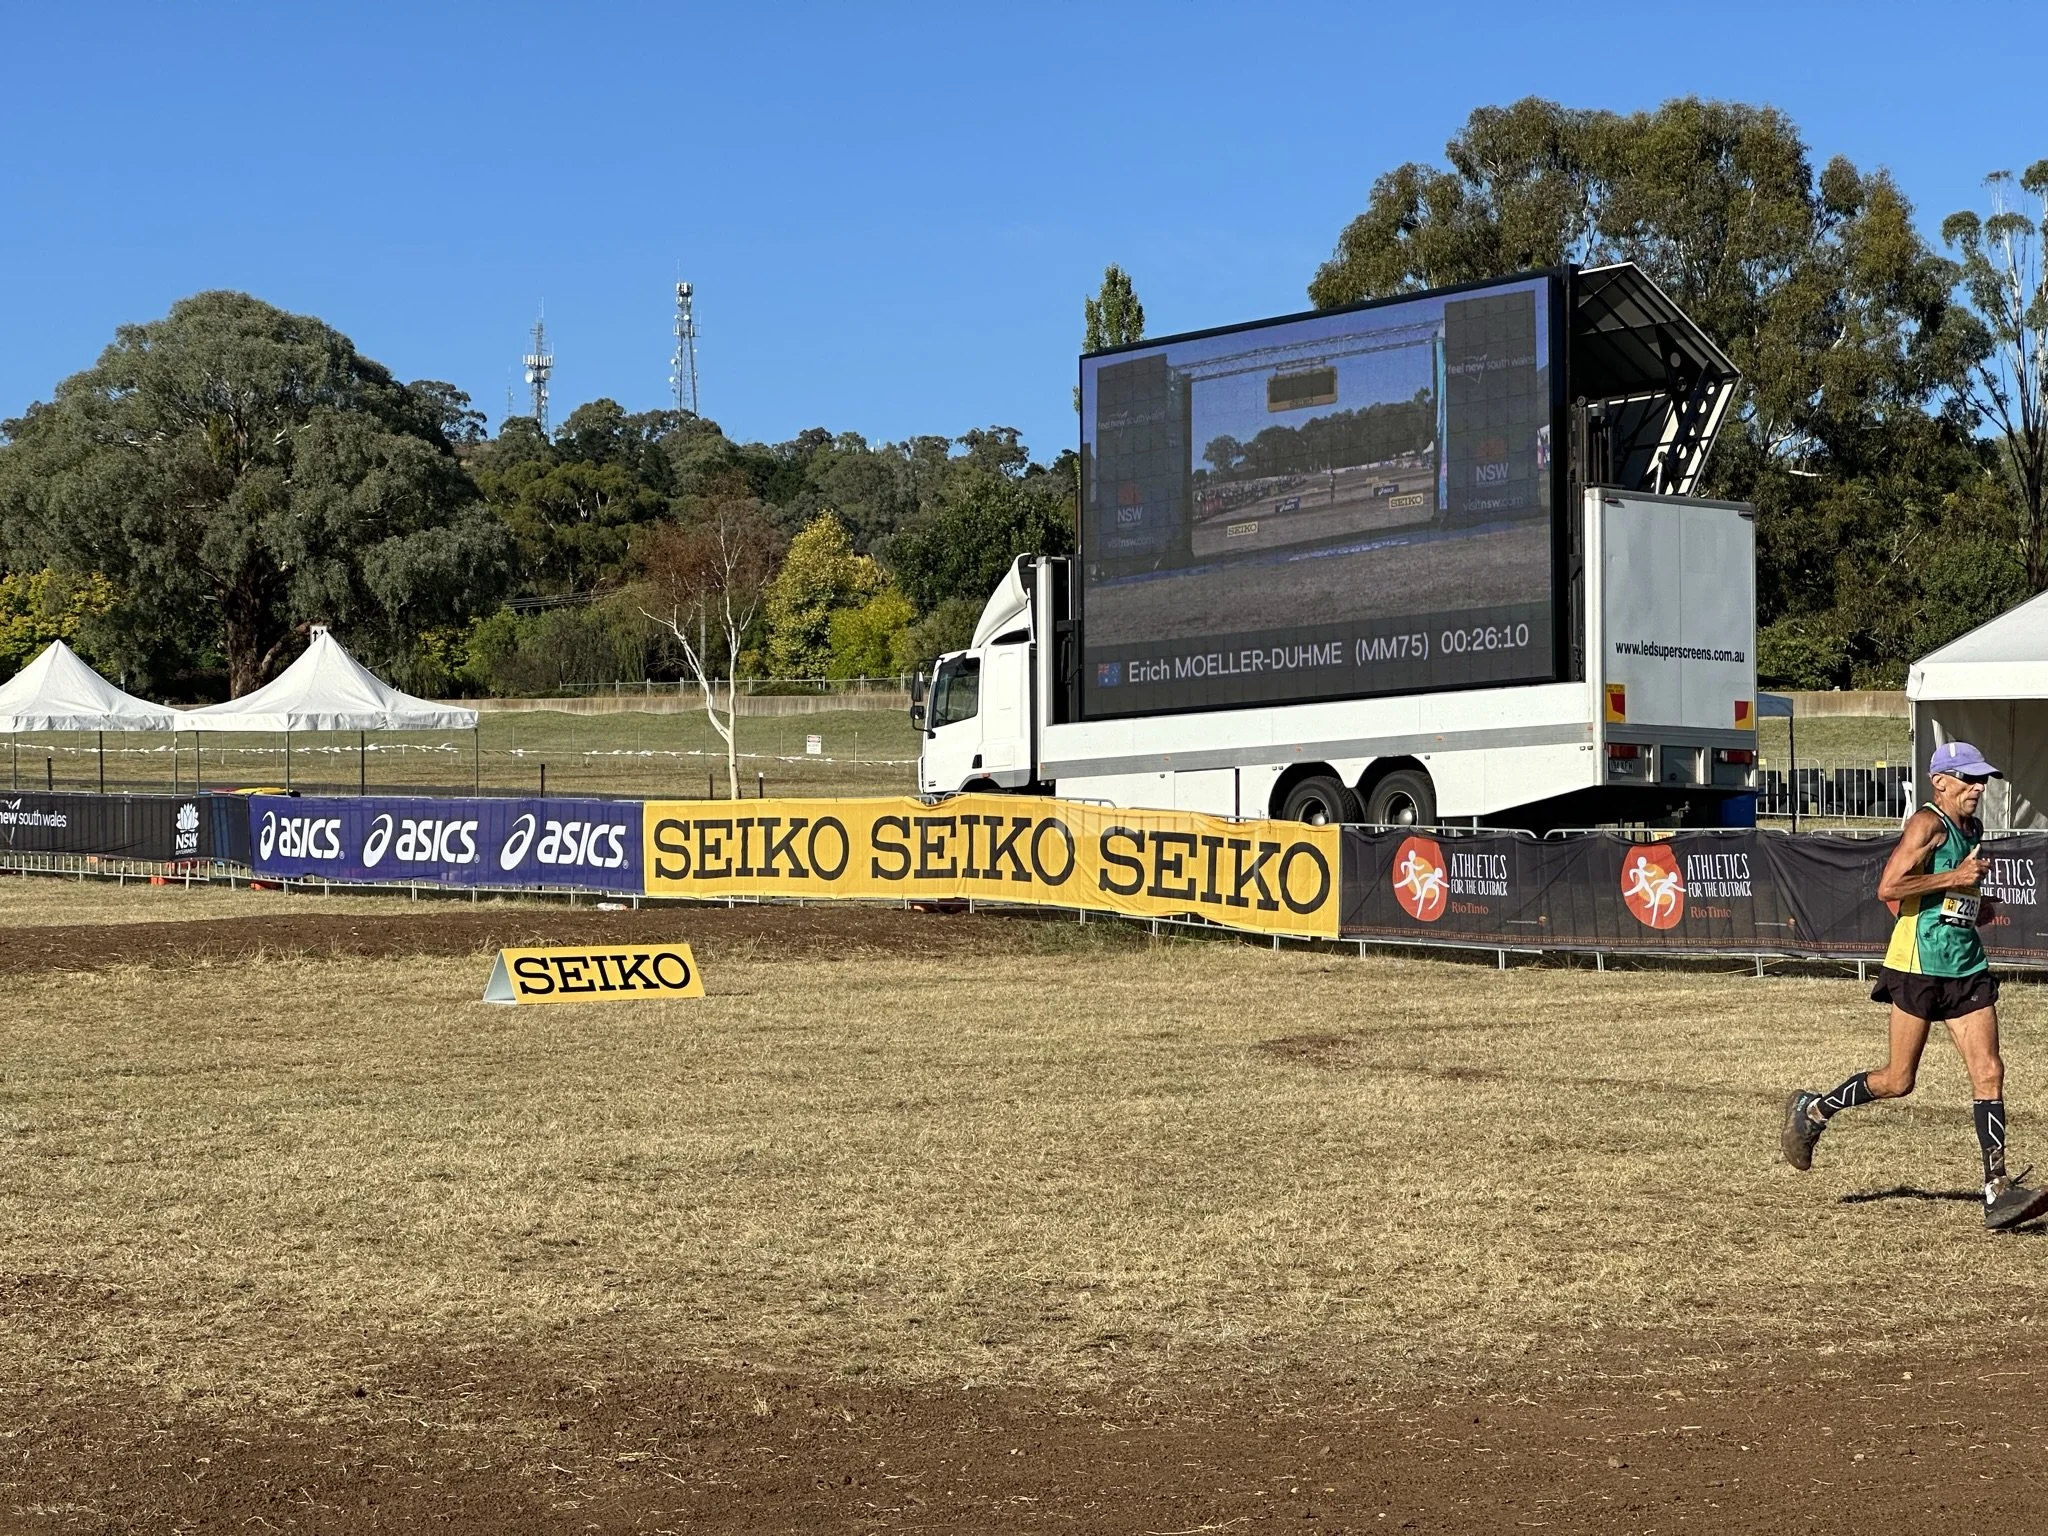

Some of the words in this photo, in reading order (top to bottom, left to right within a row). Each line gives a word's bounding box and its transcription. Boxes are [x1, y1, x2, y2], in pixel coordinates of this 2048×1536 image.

[1465, 362, 1485, 373] new
[1486, 358, 1510, 370] south
[1476, 463, 1509, 482] NSW
[1390, 495, 1422, 508] SEIKO
[1117, 506, 1143, 522] NSW
[1228, 523, 1257, 536] SEIKO
[1129, 659, 1170, 682] Erich
[1175, 642, 1342, 679] MOELLER-DUHME
[1355, 632, 1429, 667] (MM75)
[1441, 623, 1529, 654] 00:26:10
[1615, 640, 1745, 663] www.ledsuperscreens.com.au
[18, 809, 42, 826] south
[42, 810, 67, 828] wales
[175, 832, 199, 850] NSW
[653, 816, 850, 881] SEIKO
[871, 814, 1076, 887] SEIKO
[1098, 826, 1331, 914] SEIKO
[1451, 853, 1508, 879] ATHLETICS
[1687, 853, 1750, 881] ATHLETICS
[1451, 879, 1464, 894] FOR
[1465, 880, 1477, 895] THE
[1478, 880, 1508, 896] OUTBACK
[1688, 881, 1703, 898] FOR
[1703, 881, 1718, 897] THE
[1719, 881, 1752, 897] OUTBACK
[513, 952, 691, 995] SEIKO
